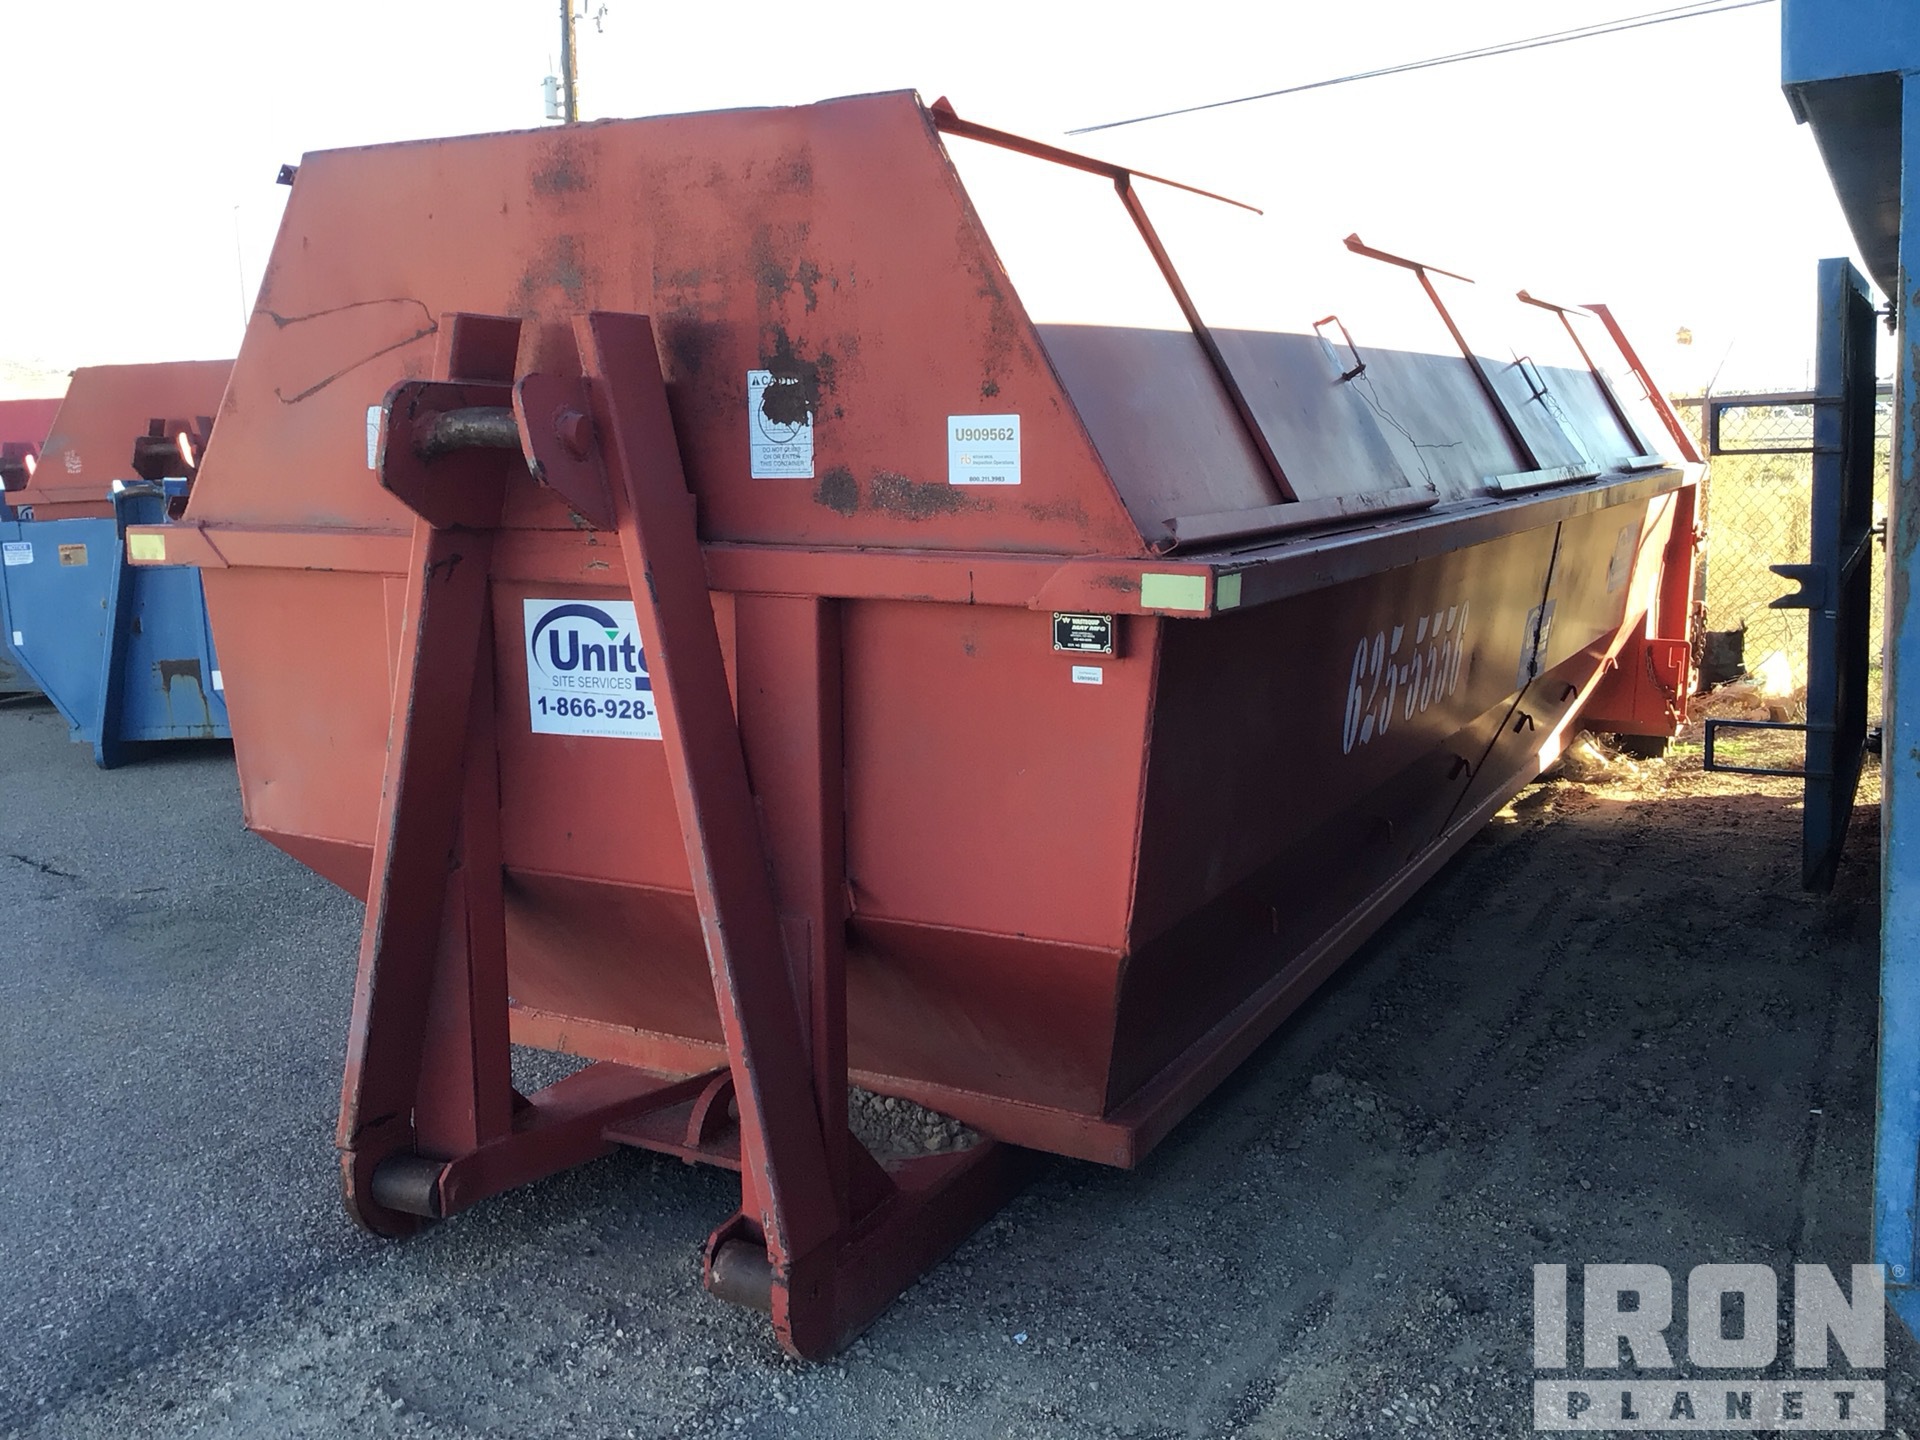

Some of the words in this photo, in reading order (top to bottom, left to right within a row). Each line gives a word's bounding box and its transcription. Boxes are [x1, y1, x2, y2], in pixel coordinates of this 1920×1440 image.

[955, 428, 1014, 441] U909562
[552, 675, 575, 688] SITE
[578, 676, 632, 690] SERVICES
[1343, 600, 1469, 755] 625-5556
[538, 696, 654, 720] 1-866-928-
